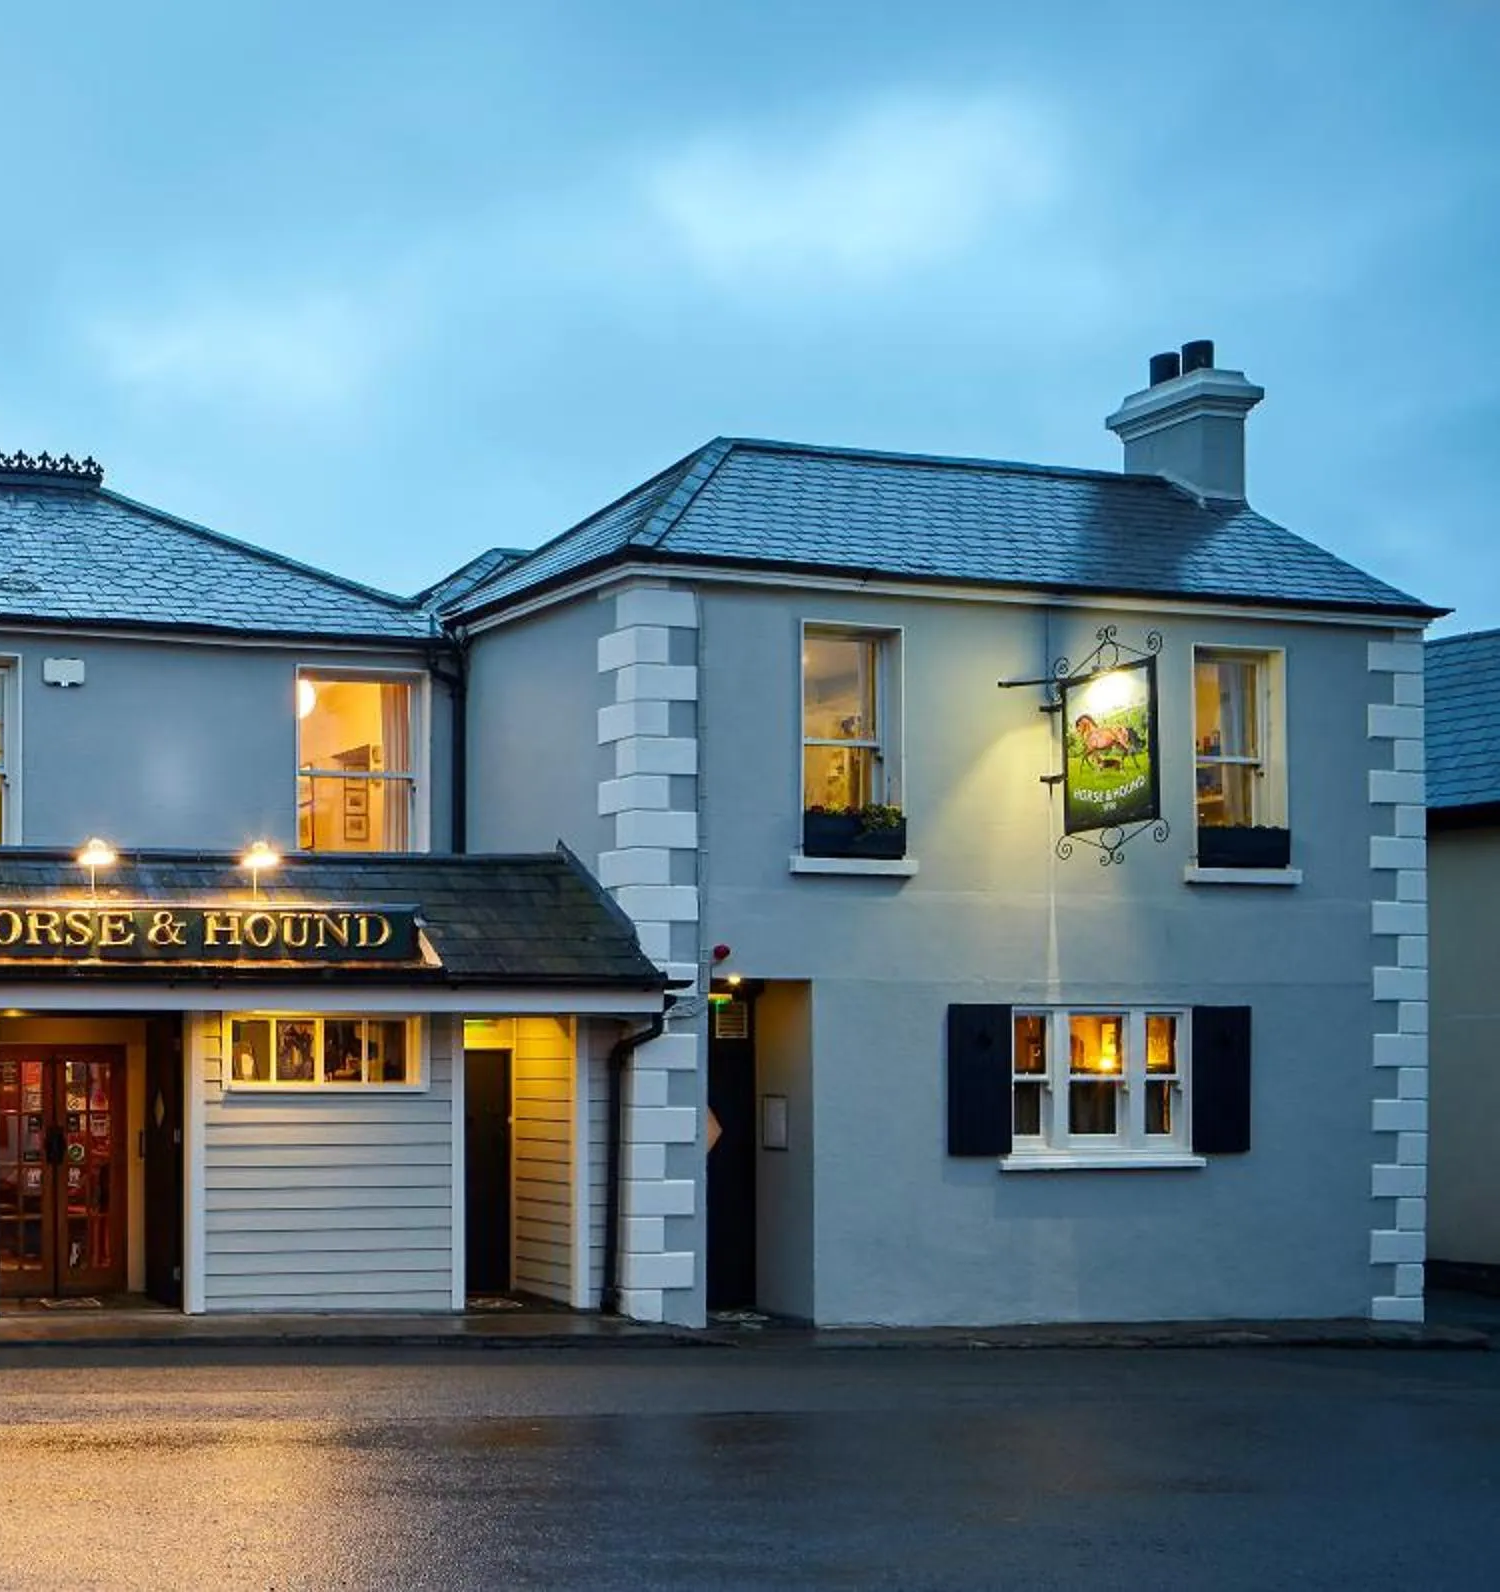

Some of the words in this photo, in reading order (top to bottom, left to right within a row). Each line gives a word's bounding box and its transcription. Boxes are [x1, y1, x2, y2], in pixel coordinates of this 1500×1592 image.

[1074, 788, 1104, 803] HORSE
[1113, 775, 1146, 798] HOUND
[148, 911, 187, 945] &
[203, 911, 392, 948] HOUND
